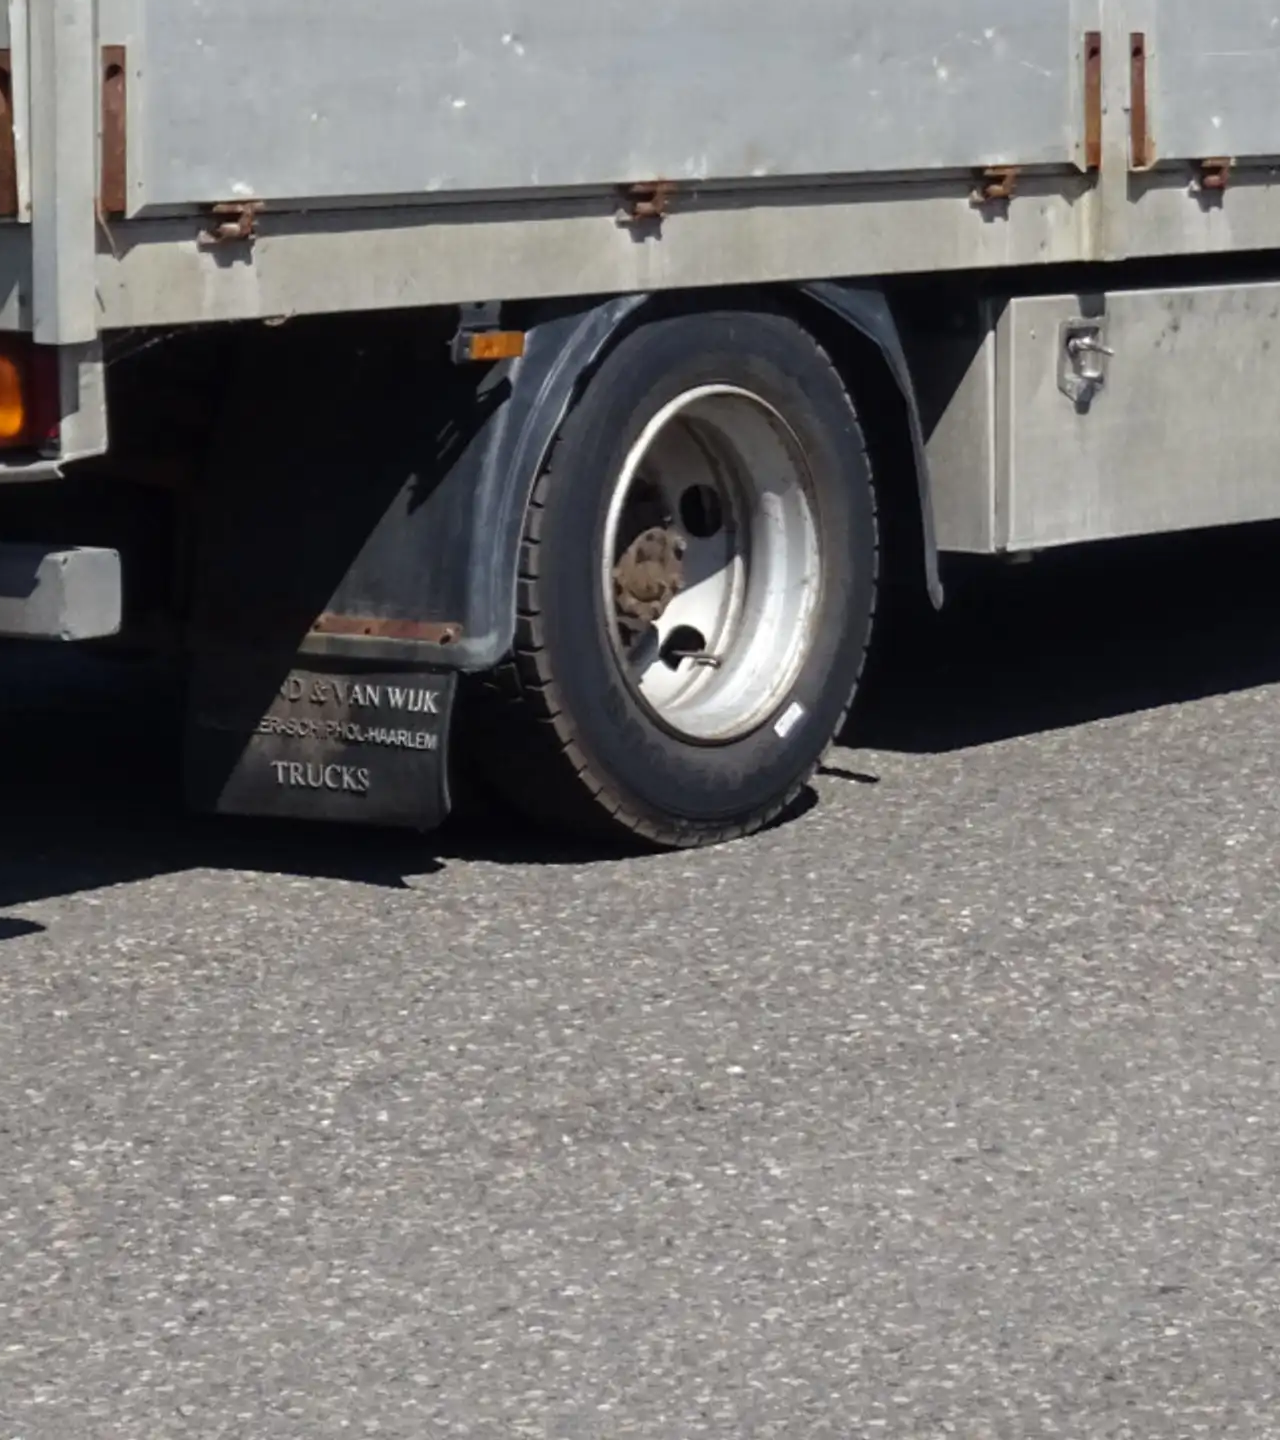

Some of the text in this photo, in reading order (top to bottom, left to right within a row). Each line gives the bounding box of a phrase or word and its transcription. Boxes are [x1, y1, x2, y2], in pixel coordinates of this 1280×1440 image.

[310, 679, 328, 702] &
[329, 681, 380, 708] VAN
[386, 686, 439, 714] WIJK
[260, 716, 438, 750] ER-SCHPHOL-HAARLEM
[270, 760, 371, 791] TRUCKS
